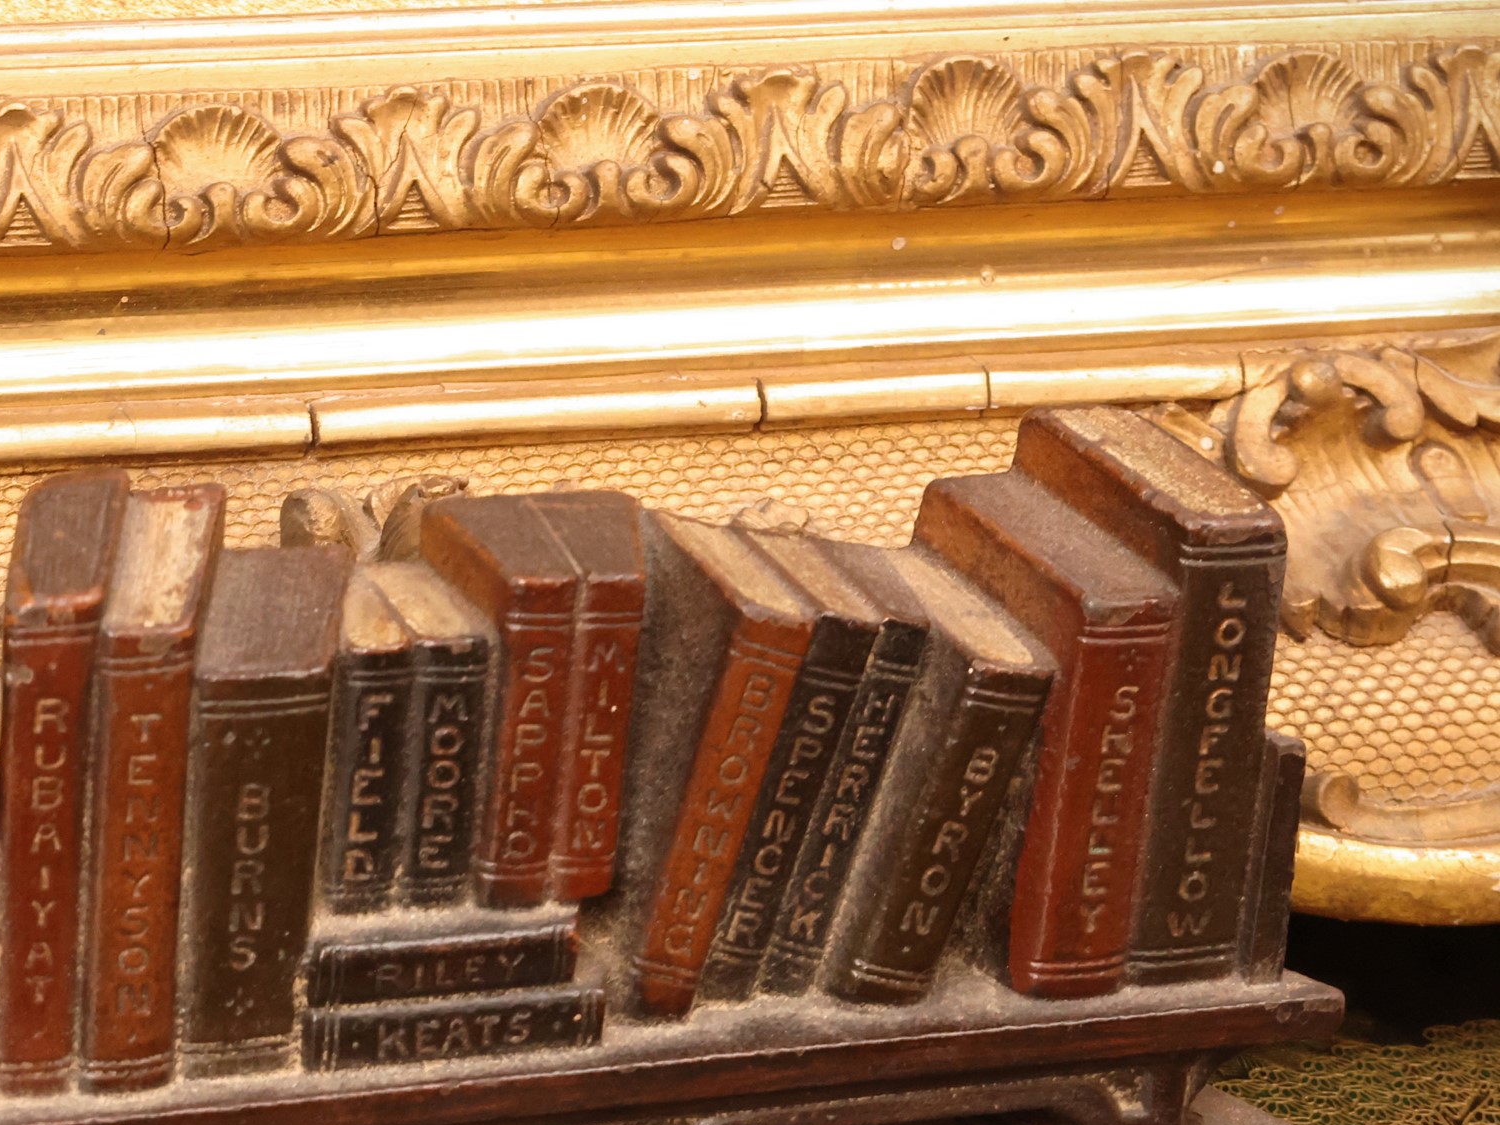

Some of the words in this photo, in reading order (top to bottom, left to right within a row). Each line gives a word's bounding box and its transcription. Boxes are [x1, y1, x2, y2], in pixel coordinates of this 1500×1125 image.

[25, 698, 67, 1002] RUBAIYAT
[343, 694, 393, 881] FIELD
[419, 695, 467, 868] MOORE
[572, 641, 625, 849] MILTON
[664, 673, 775, 955] BROWNING
[727, 695, 836, 944] SPENCER
[788, 693, 895, 938] HERRICK
[901, 747, 999, 936] BYRON
[1082, 686, 1139, 933] SHELLEY
[1167, 582, 1245, 936] LONGFELLOW
[116, 713, 162, 1016] TENNYSON
[228, 784, 270, 970] BURNS
[370, 952, 525, 986] RILEY
[377, 1012, 532, 1055] KEATS
